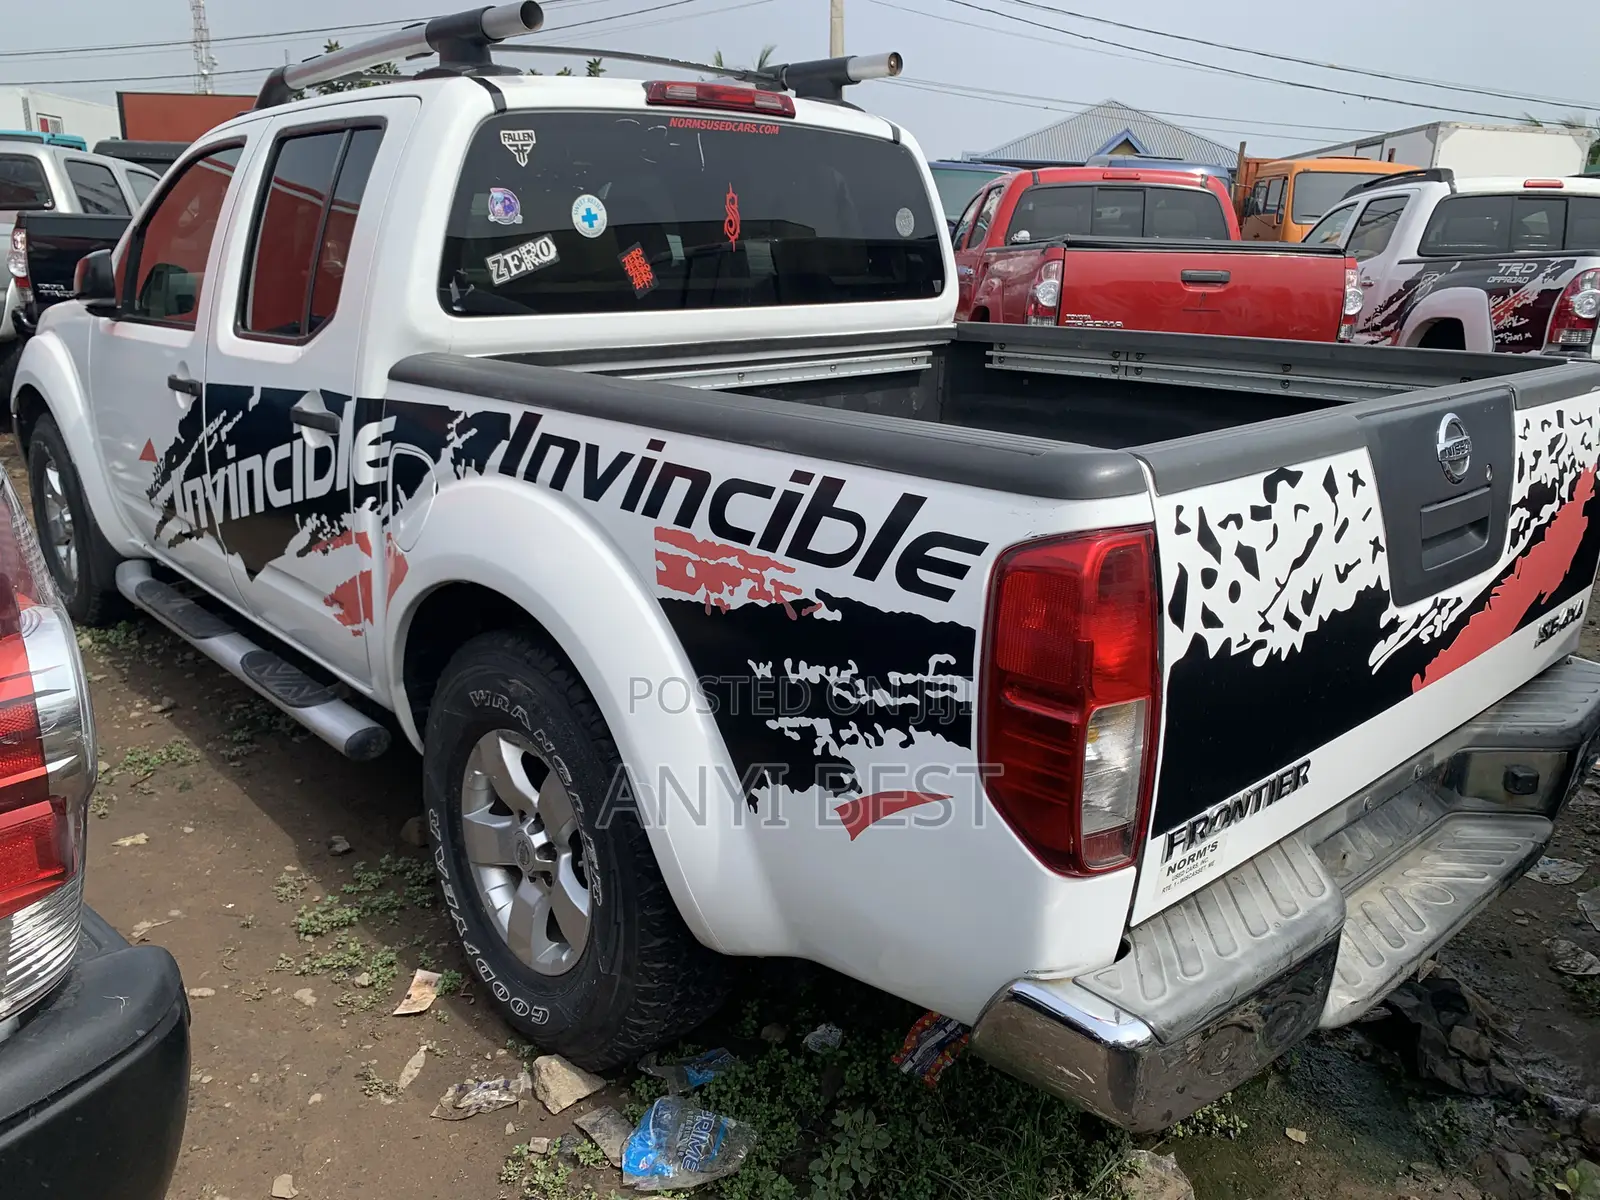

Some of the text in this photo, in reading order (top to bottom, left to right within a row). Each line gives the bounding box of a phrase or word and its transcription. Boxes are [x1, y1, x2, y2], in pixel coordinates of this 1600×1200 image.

[502, 132, 534, 143] FALLEN
[669, 118, 779, 134] NORMSUSEDCARS.COM
[486, 237, 557, 285] ZERO
[1498, 262, 1538, 276] TRD
[1487, 275, 1530, 284] OFFROAD
[498, 411, 989, 603] Invincible
[1161, 758, 1311, 864] FRONTIER
[1167, 841, 1218, 877] NORM'S
[428, 808, 550, 1025] GOODYEAR
